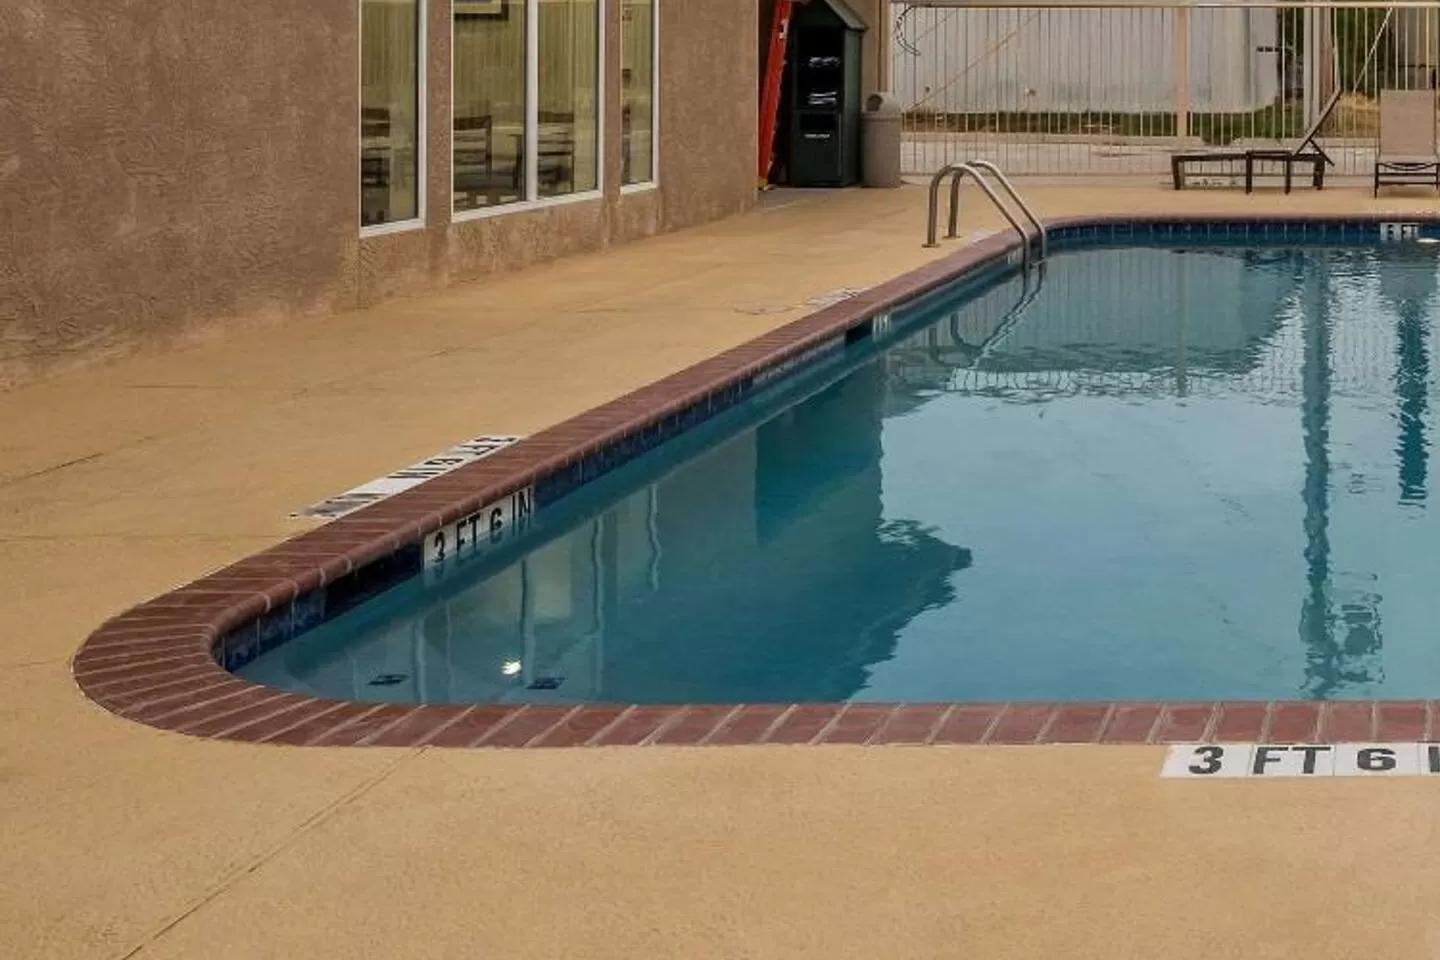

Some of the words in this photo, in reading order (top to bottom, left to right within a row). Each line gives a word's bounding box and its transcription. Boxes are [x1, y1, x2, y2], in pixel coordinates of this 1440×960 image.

[1187, 746, 1224, 775] 3
[1252, 746, 1331, 775] FT
[1356, 747, 1397, 772] 6
